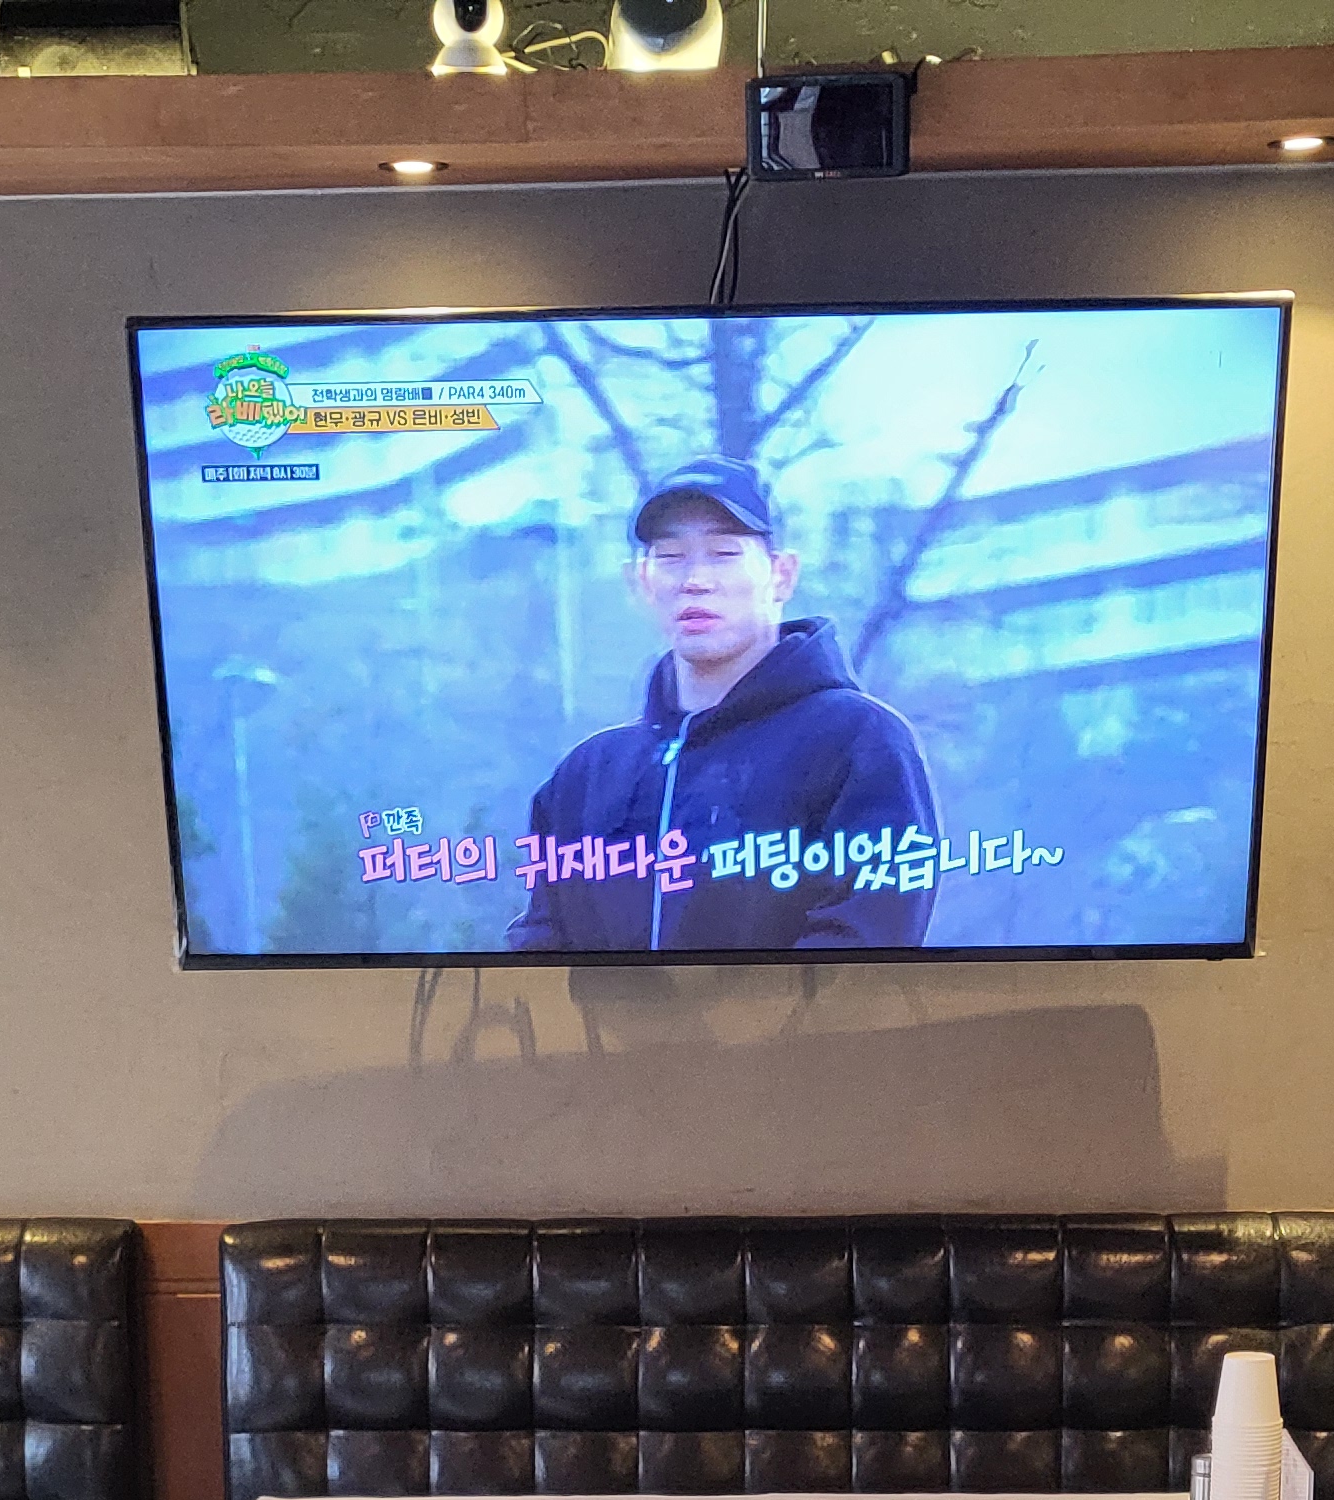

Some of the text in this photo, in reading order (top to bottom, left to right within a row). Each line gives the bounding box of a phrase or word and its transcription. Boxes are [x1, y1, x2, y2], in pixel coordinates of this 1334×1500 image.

[311, 387, 377, 403] 전학생과의
[448, 385, 485, 400] PAR4
[488, 384, 526, 400] 340m
[386, 409, 408, 427] VS
[381, 806, 424, 837] 만족
[359, 832, 497, 886] 퍼터의
[513, 826, 698, 894] 귀재다운
